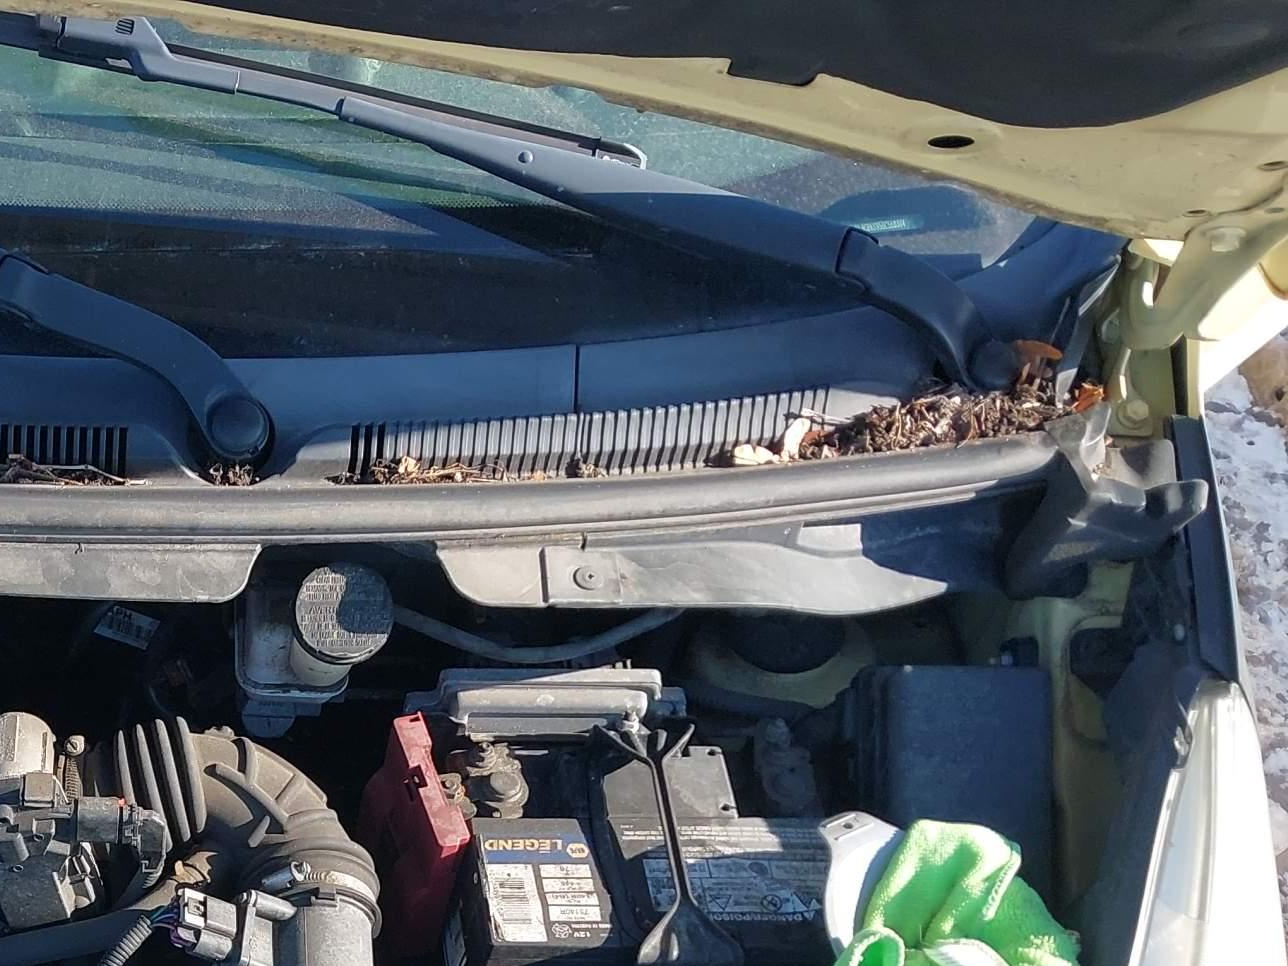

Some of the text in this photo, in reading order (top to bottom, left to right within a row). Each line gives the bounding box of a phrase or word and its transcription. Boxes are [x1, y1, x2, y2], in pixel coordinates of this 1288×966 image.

[484, 838, 563, 853] LEGEND
[710, 911, 803, 921] DANGER/POISO
[573, 930, 591, 938] 12V
